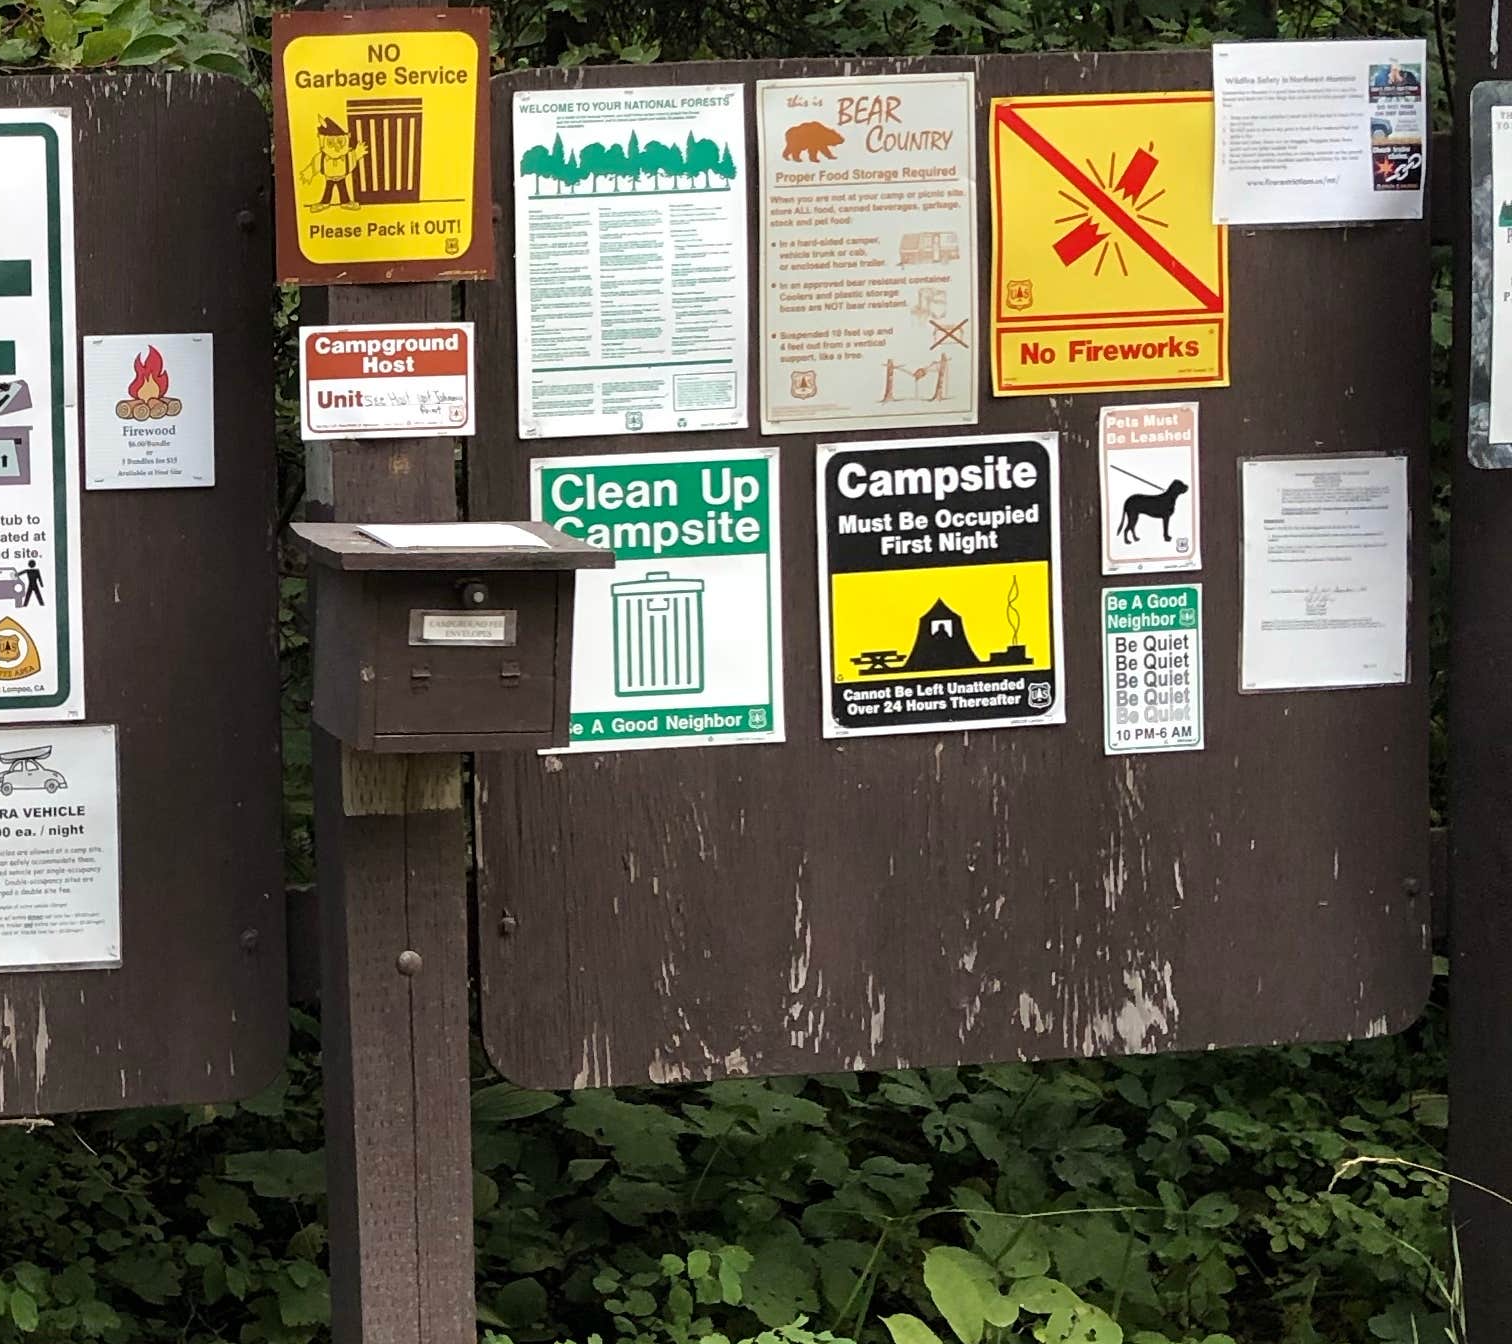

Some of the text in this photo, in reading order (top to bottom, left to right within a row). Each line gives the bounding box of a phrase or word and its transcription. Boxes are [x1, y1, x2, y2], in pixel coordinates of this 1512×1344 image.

[368, 44, 400, 63] NO
[294, 66, 467, 89] Garbage Service
[519, 97, 729, 113] WELCOME TO YOUR NATIONAL FORESTS
[786, 95, 902, 125] this is BEAR
[776, 166, 956, 184] Proper Food Storage Required
[309, 219, 461, 240] Please Pack it OUT!
[315, 334, 458, 355] Campground
[1021, 337, 1199, 365] No Fireworks
[363, 356, 414, 373] Host
[318, 390, 363, 408] Unit
[122, 425, 176, 437] Firewood
[1106, 414, 1178, 430] Pets Must
[1106, 429, 1190, 445] Be Leashed
[837, 455, 1038, 501] Campsite
[550, 468, 759, 514] Clean Up
[838, 504, 1039, 534] Must Be Occupied
[553, 511, 760, 554] Campsite
[881, 530, 998, 555] First Night
[1107, 593, 1187, 610] Be A Good
[1107, 613, 1176, 631] Neighbor
[1115, 634, 1189, 653] Be Quiet
[1116, 652, 1189, 671] Be Quiet
[1116, 670, 1190, 689] Be Quiet
[843, 678, 1025, 702] Cannot Be Left Unattended
[1116, 688, 1190, 706] Be Quiet
[847, 693, 1022, 715] Over 24 Hours Thereafter
[591, 719, 604, 734] A
[612, 717, 658, 732] Good
[666, 714, 743, 732] Neighbor
[1117, 730, 1130, 741] 10
[1171, 726, 1192, 737] AM
[23, 806, 85, 818] VEHICLE
[16, 828, 36, 836] ea.
[40, 825, 45, 836] /
[49, 825, 84, 838] night
